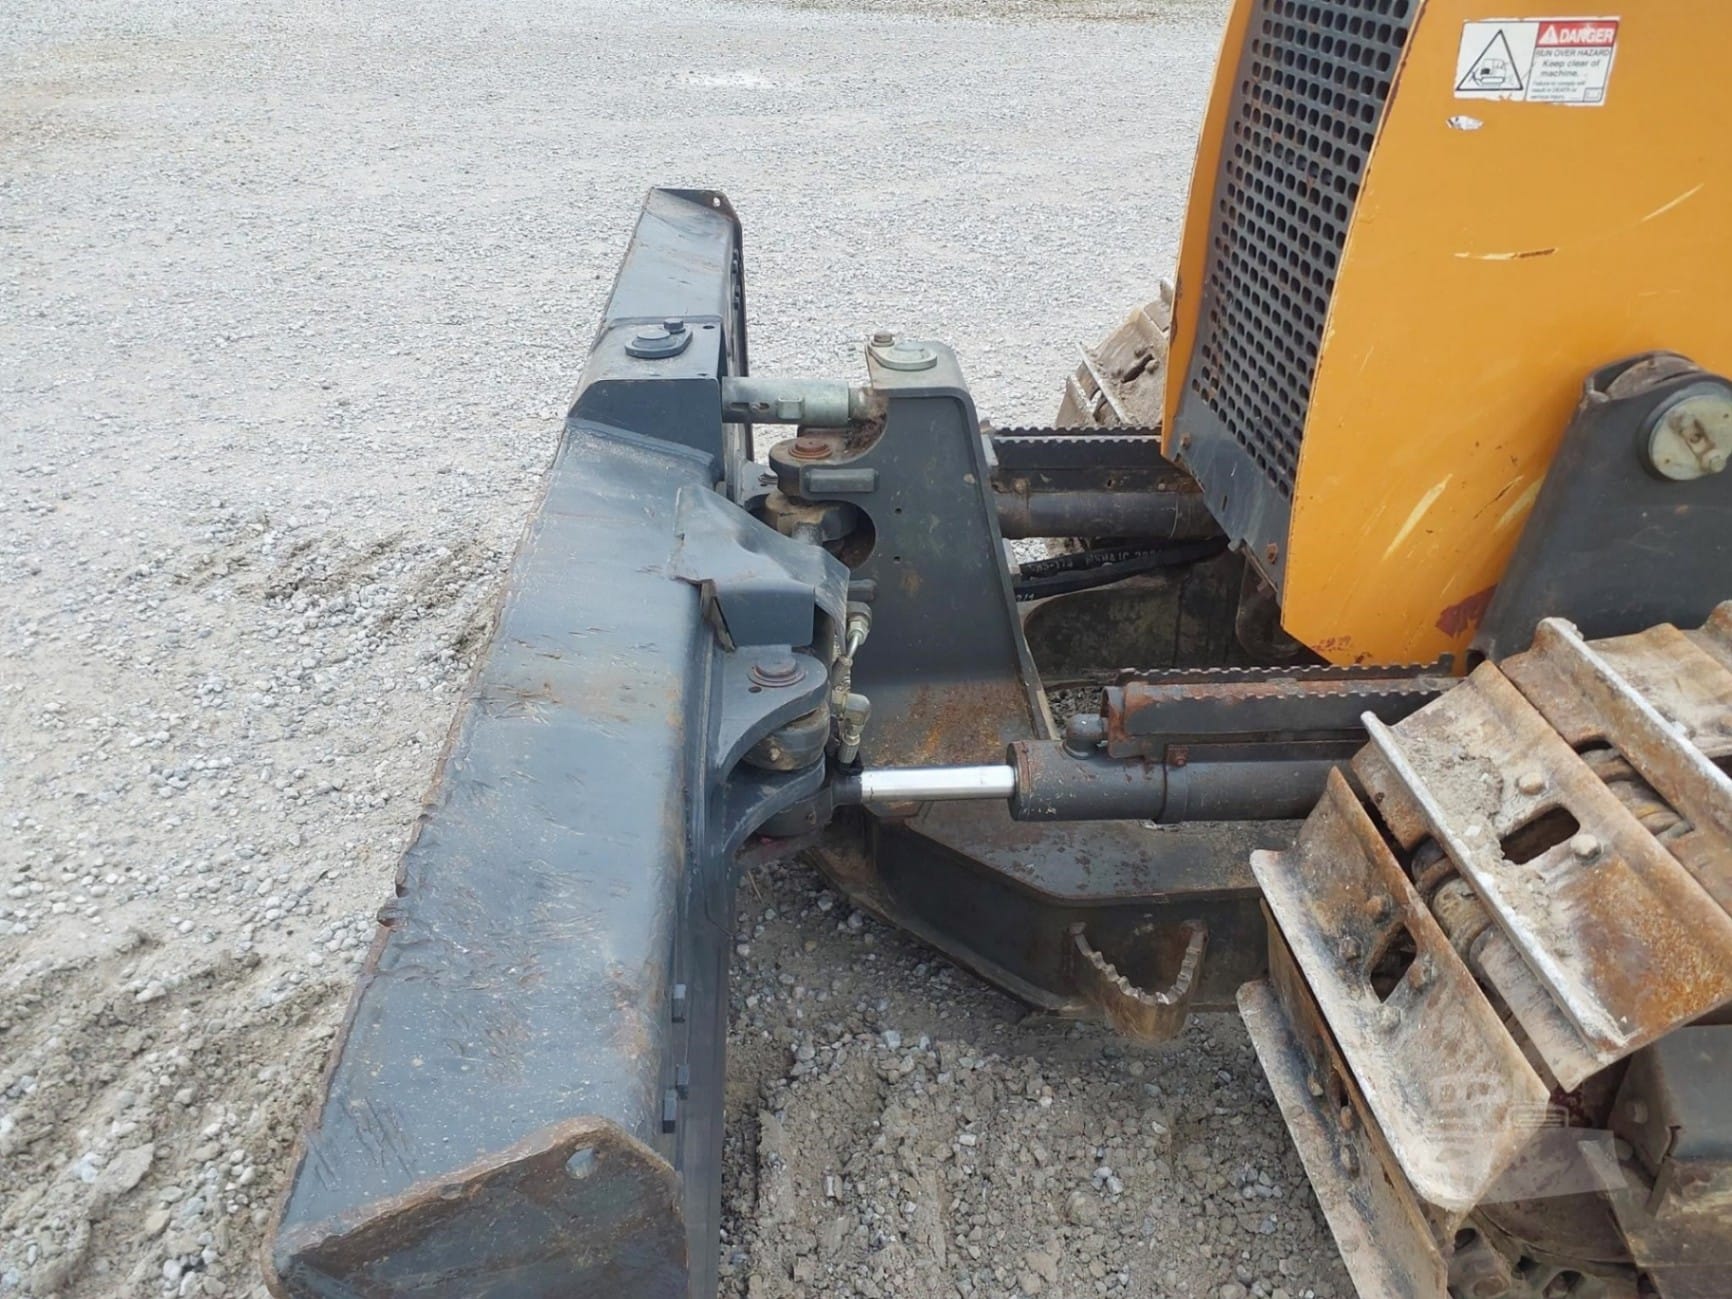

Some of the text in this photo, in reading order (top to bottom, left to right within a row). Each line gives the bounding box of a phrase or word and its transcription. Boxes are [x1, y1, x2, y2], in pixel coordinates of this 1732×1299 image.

[1559, 28, 1616, 44] DANGER
[1535, 48, 1610, 57] RUN OVER HAZARD
[1542, 59, 1601, 68] Keep clear of
